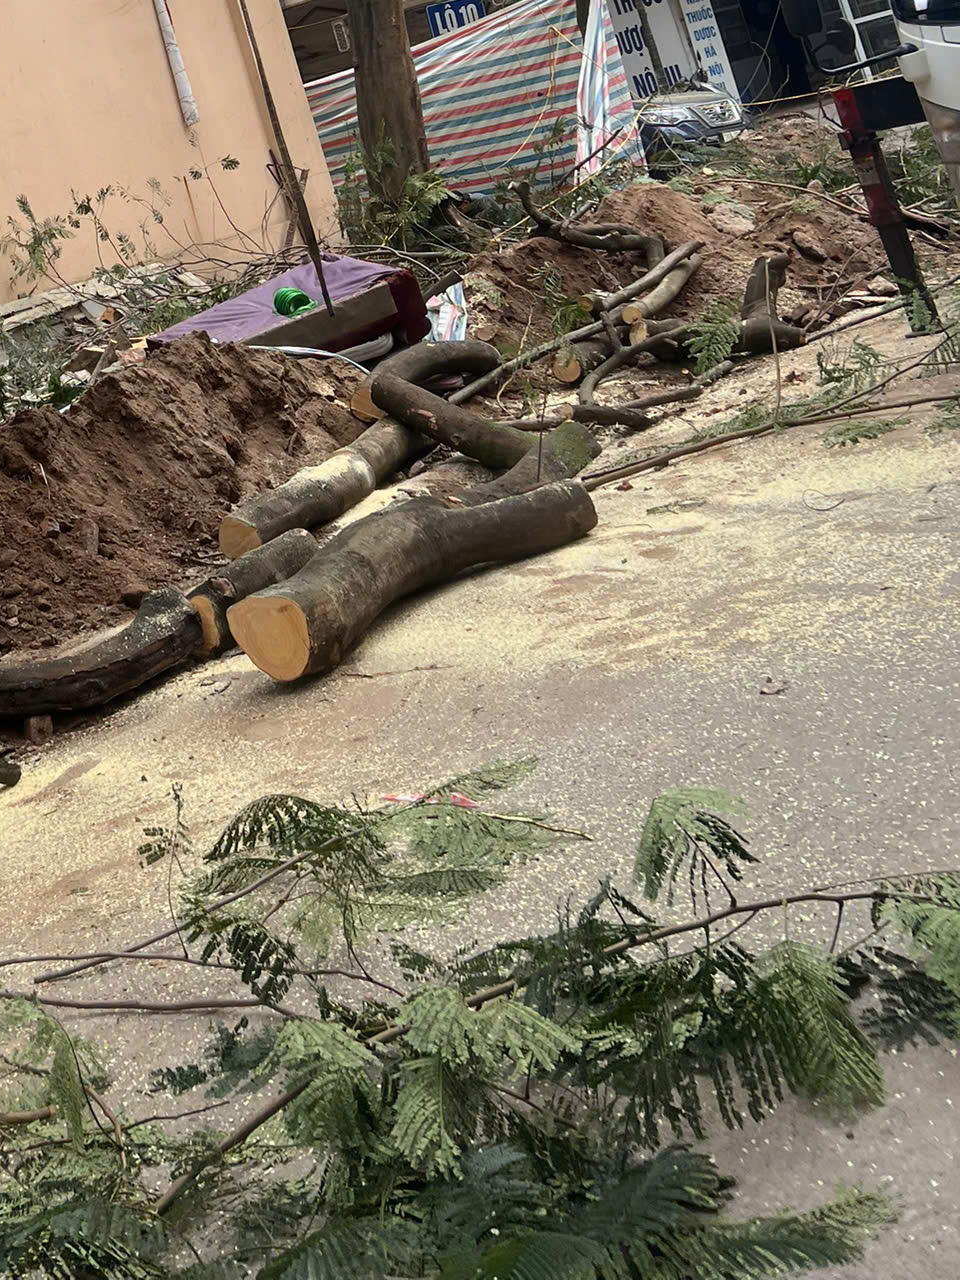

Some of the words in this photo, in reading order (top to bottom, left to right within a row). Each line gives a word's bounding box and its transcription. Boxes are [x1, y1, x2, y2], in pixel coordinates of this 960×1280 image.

[434, 3, 458, 34] LÔ
[458, 3, 479, 25] 10
[685, 4, 713, 24] THUỐC
[704, 43, 717, 58] HÀ
